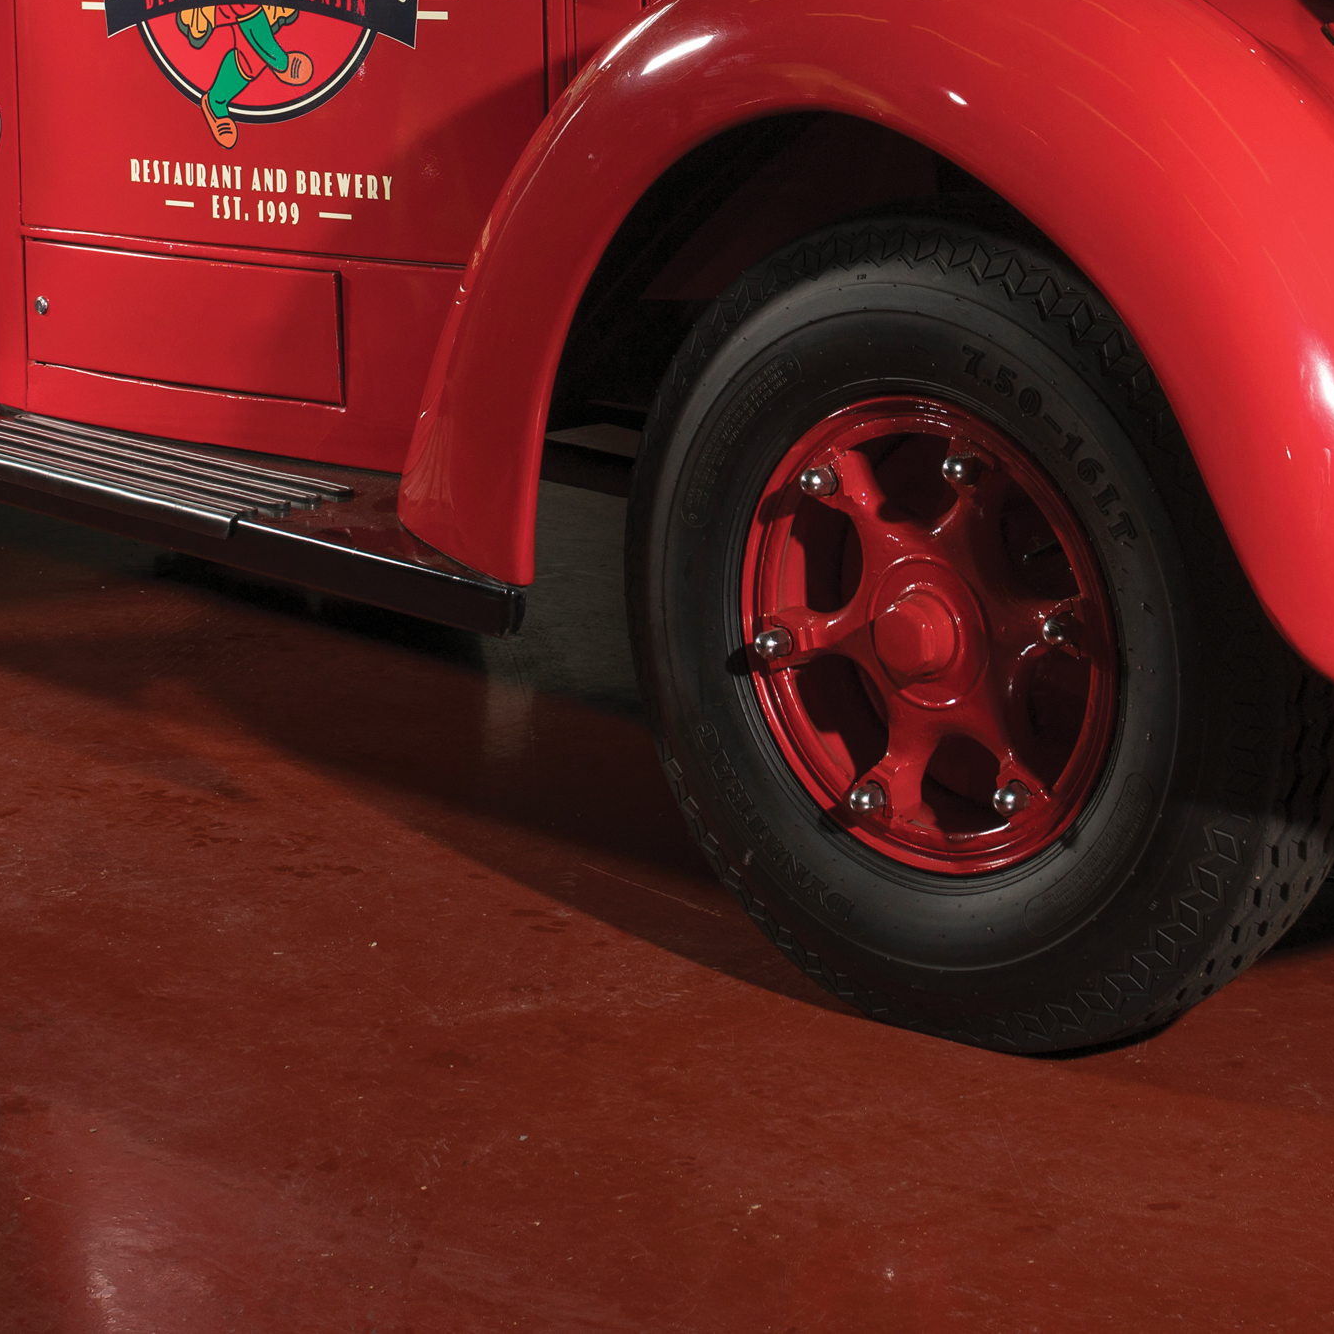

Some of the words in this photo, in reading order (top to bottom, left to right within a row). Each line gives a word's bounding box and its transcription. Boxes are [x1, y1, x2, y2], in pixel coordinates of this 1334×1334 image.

[129, 158, 243, 191] RESTAURANT
[251, 167, 288, 194] AND
[295, 170, 393, 201] BREWERY
[211, 196, 250, 222] EST.
[257, 200, 300, 225] 1999
[961, 343, 1139, 542] 7.50-16LT
[696, 720, 855, 922] DYNATRAC
